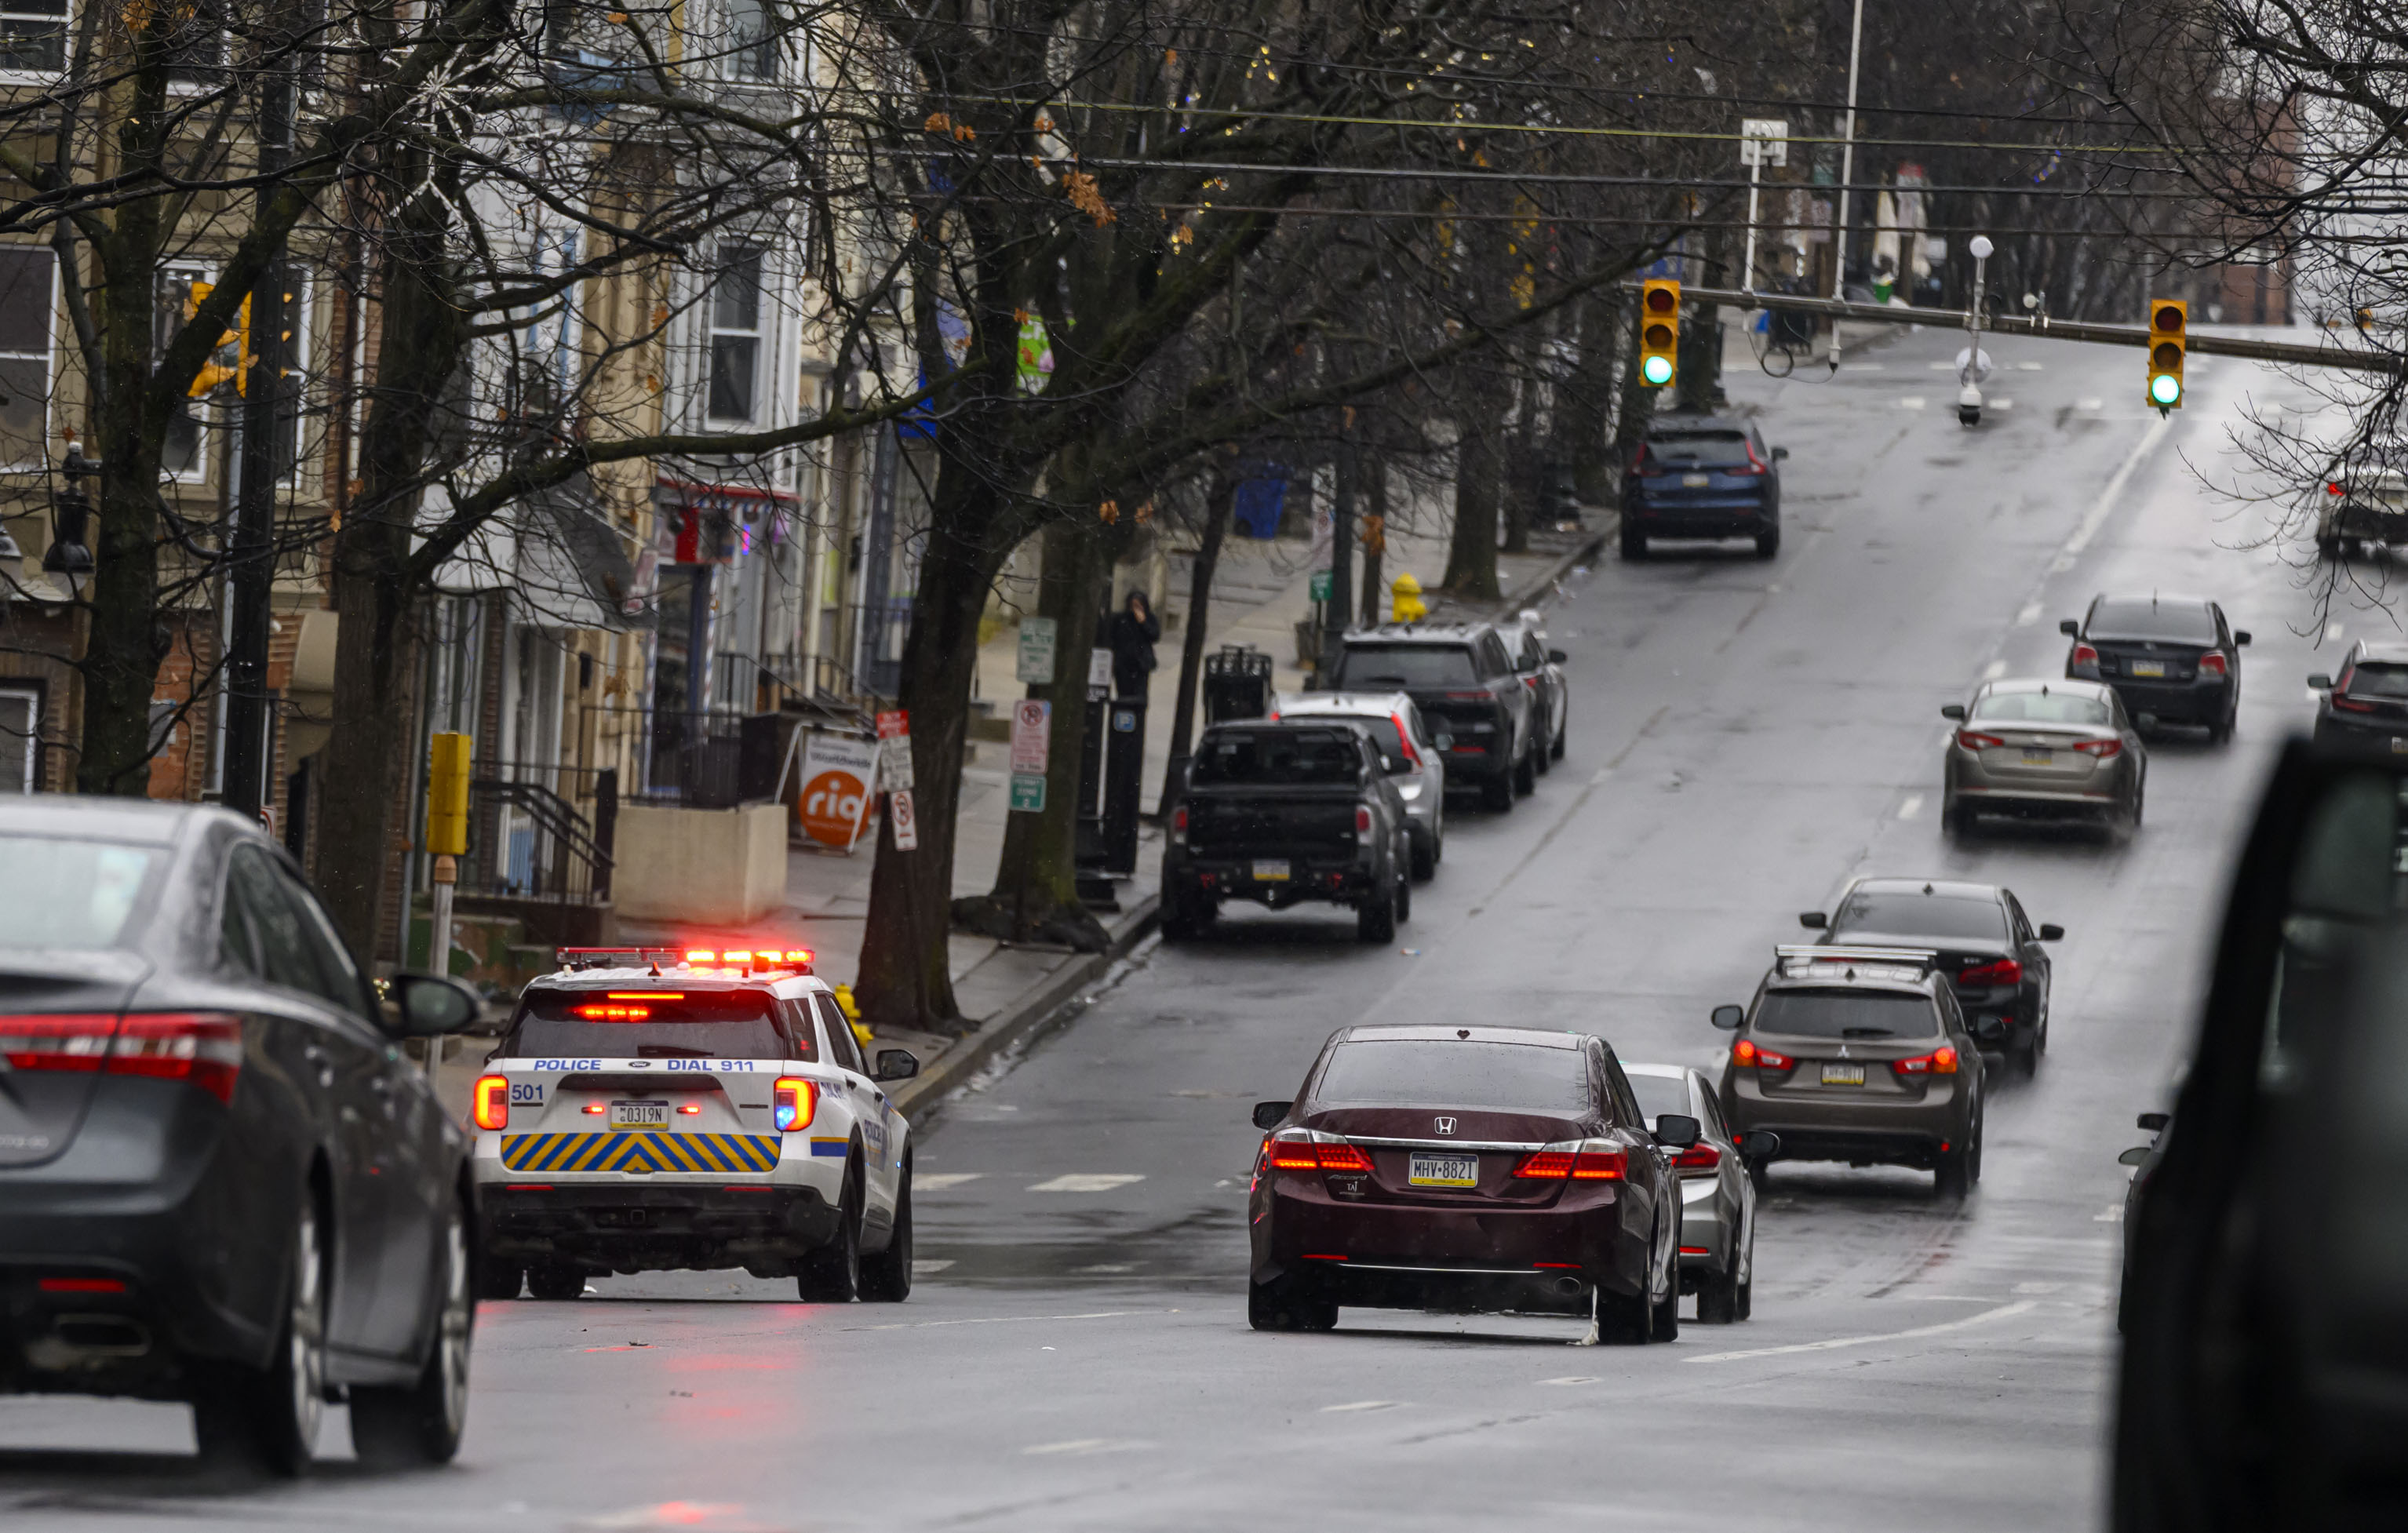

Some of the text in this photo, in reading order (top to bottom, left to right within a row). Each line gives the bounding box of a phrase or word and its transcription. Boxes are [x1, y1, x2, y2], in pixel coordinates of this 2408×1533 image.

[534, 1060, 602, 1071] POLICE
[668, 1060, 754, 1072] DIAL 911
[512, 1084, 543, 1100] 501
[627, 1107, 662, 1122] 0319N
